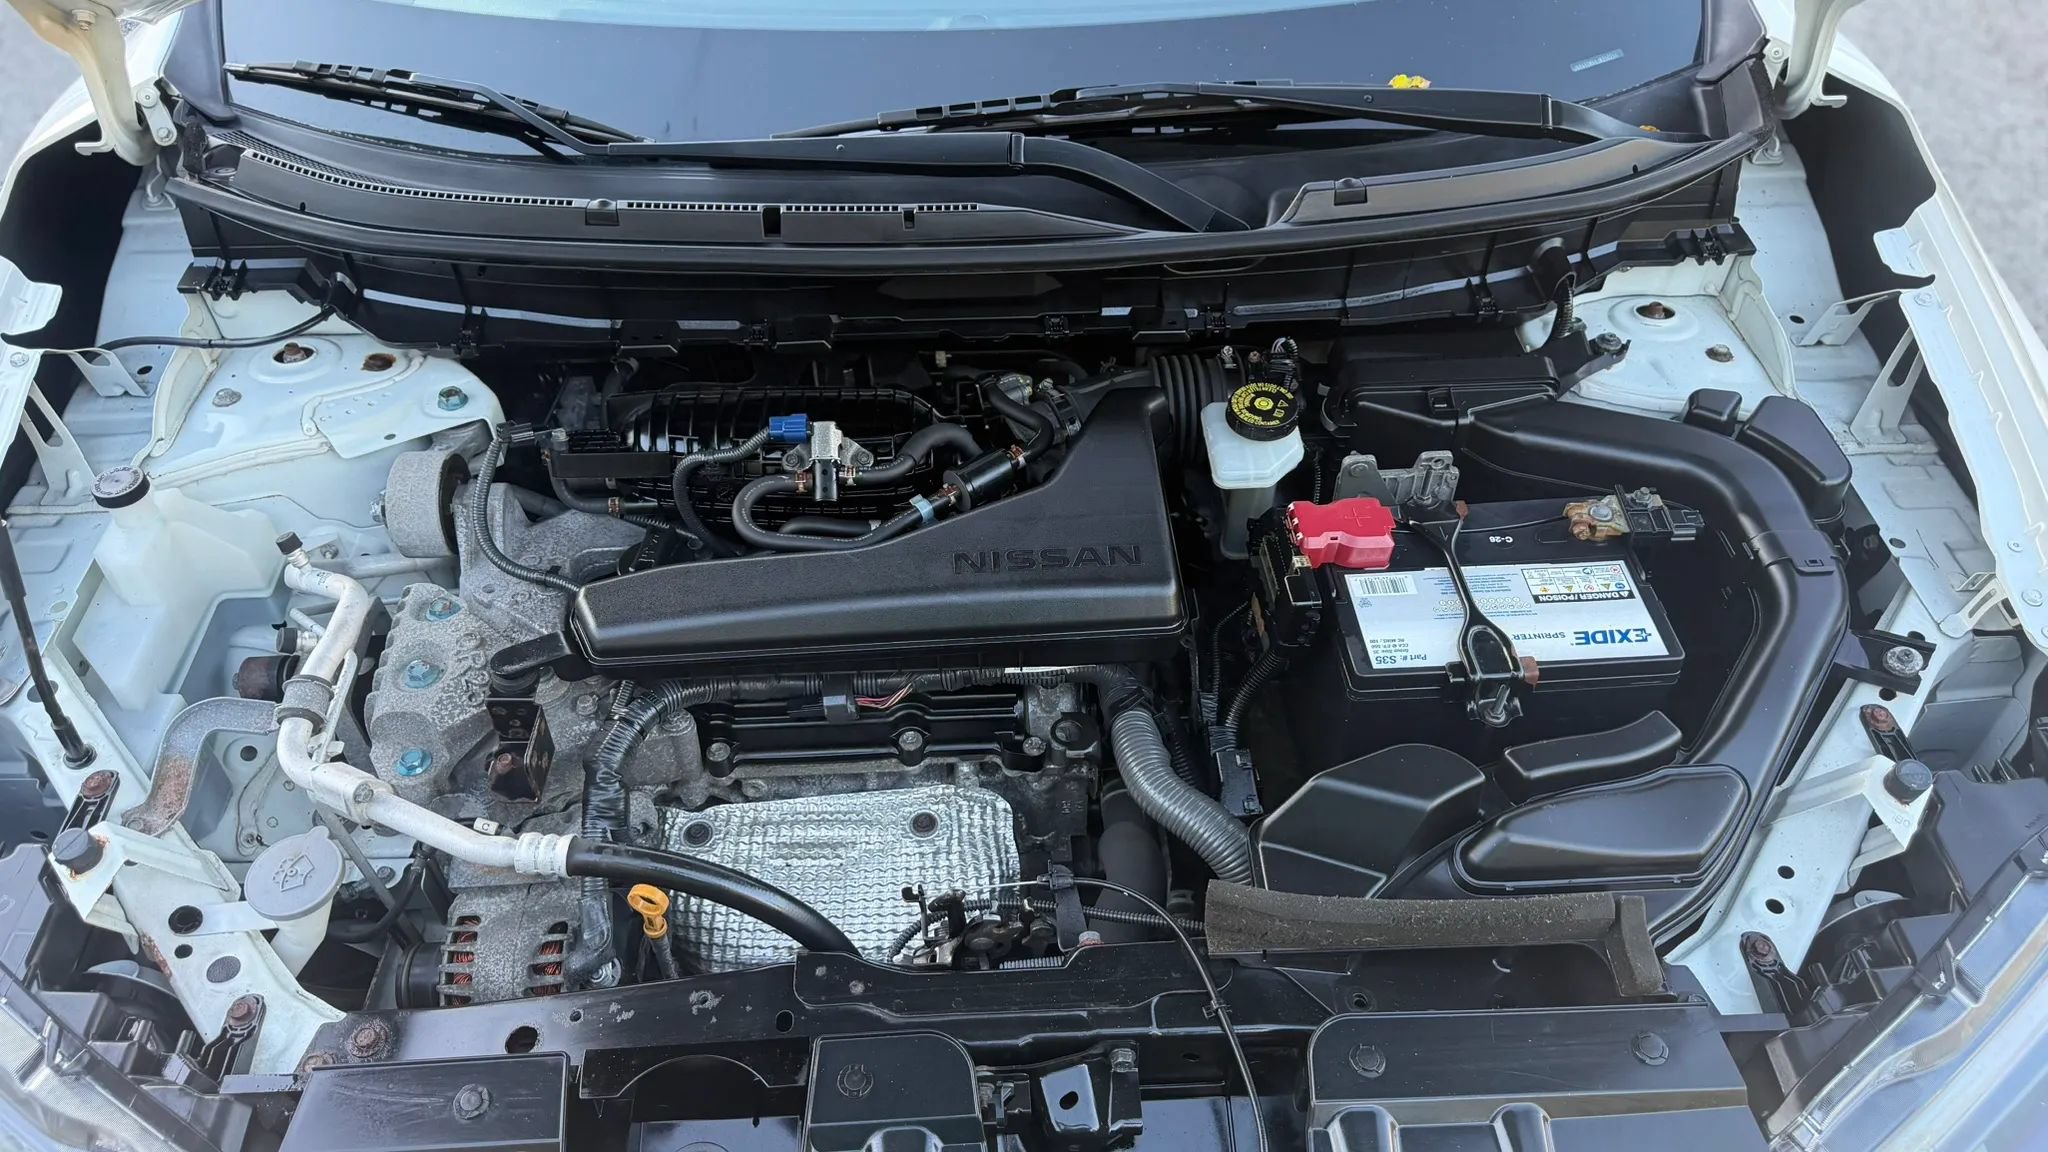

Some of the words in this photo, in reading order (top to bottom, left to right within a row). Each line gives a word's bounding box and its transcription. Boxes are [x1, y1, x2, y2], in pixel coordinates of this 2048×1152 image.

[952, 545, 1144, 575] NISSAN
[1579, 590, 1620, 600] DANGER
[1512, 631, 1566, 641] SPRINTER
[1573, 628, 1651, 646] EXIDE
[1375, 656, 1397, 664] S35
